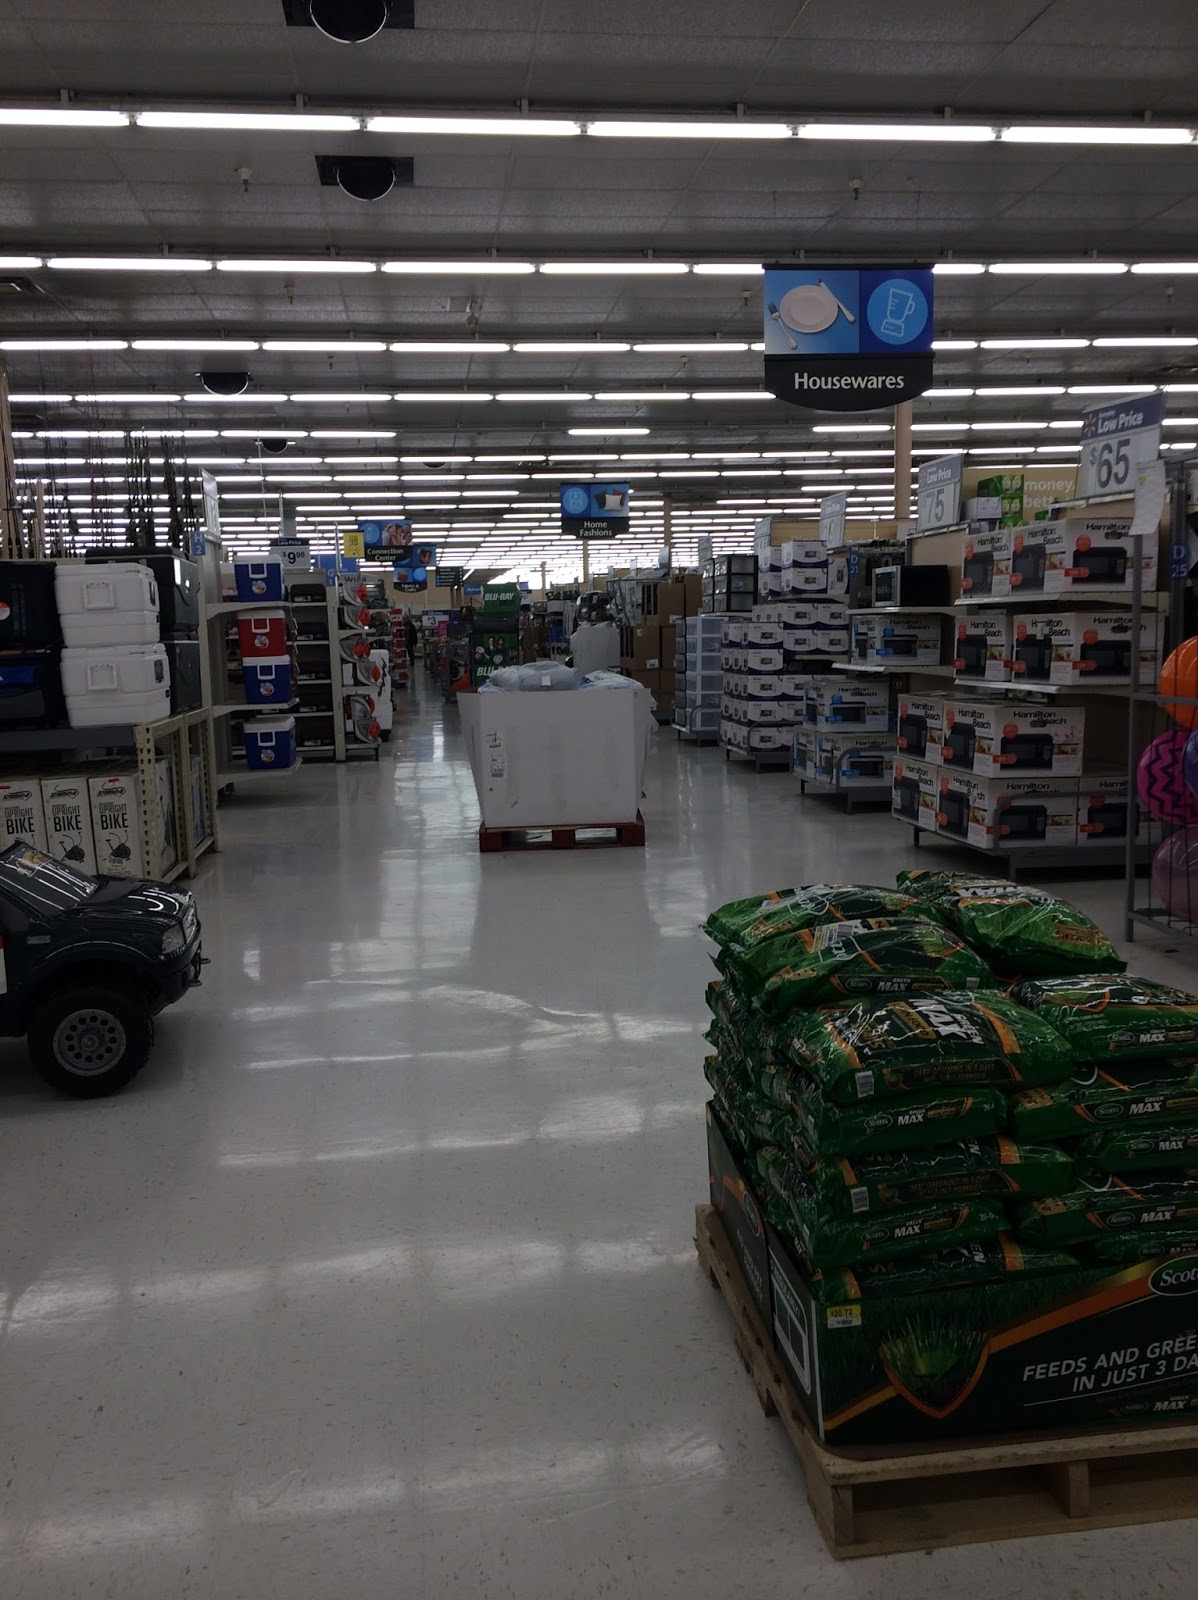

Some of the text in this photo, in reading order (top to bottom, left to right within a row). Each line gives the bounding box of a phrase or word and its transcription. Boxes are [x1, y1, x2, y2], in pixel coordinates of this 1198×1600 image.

[794, 372, 905, 390] Housewares
[1097, 410, 1144, 434] Low Price
[1023, 494, 1055, 508] bett
[583, 520, 608, 529] Home
[579, 529, 613, 537] Fashions
[1028, 527, 1057, 539] Hamilton
[977, 536, 1003, 546] Hamilton
[1043, 535, 1064, 545] Beach
[196, 546, 202, 555] 2
[990, 544, 1009, 553] Beach
[1172, 544, 1186, 560] D
[850, 554, 859, 564] D
[849, 565, 859, 574] 21
[1171, 563, 1188, 577] 25
[484, 593, 514, 601] BLU-RAY
[970, 620, 996, 629] Hamilton
[984, 628, 1003, 637] Beach
[1048, 627, 1071, 637] Beach
[910, 701, 935, 711] Hamilton
[924, 710, 941, 721] Beach
[958, 708, 985, 719] Hamilton
[1013, 710, 1056, 718] Hamilton
[972, 718, 991, 730] Beach
[1037, 717, 1067, 725] Bach
[906, 764, 929, 776] Hamilton
[917, 775, 934, 787] Beach
[1006, 782, 1050, 790] Hamilton
[4, 807, 33, 818] UPRIGHT
[52, 805, 81, 816] UPRIGHT
[98, 803, 127, 814] UPRIGHT
[5, 817, 35, 835] BIKE
[53, 814, 82, 832] BIKE
[100, 812, 129, 830] BIKE
[876, 982, 909, 992] MAX
[1139, 1032, 1167, 1044] MAX
[1129, 1102, 1163, 1115] MAX
[897, 1113, 925, 1126] MAX
[1158, 1139, 1184, 1151] MAX
[1140, 1210, 1174, 1224] MAX
[894, 1225, 921, 1239] MAX
[1159, 1267, 1198, 1287] Scot
[1022, 1334, 1198, 1382] FEEDS AND GREE
[1072, 1353, 1198, 1392] IN JUST 3 DA
[1152, 1400, 1187, 1412] MAX
